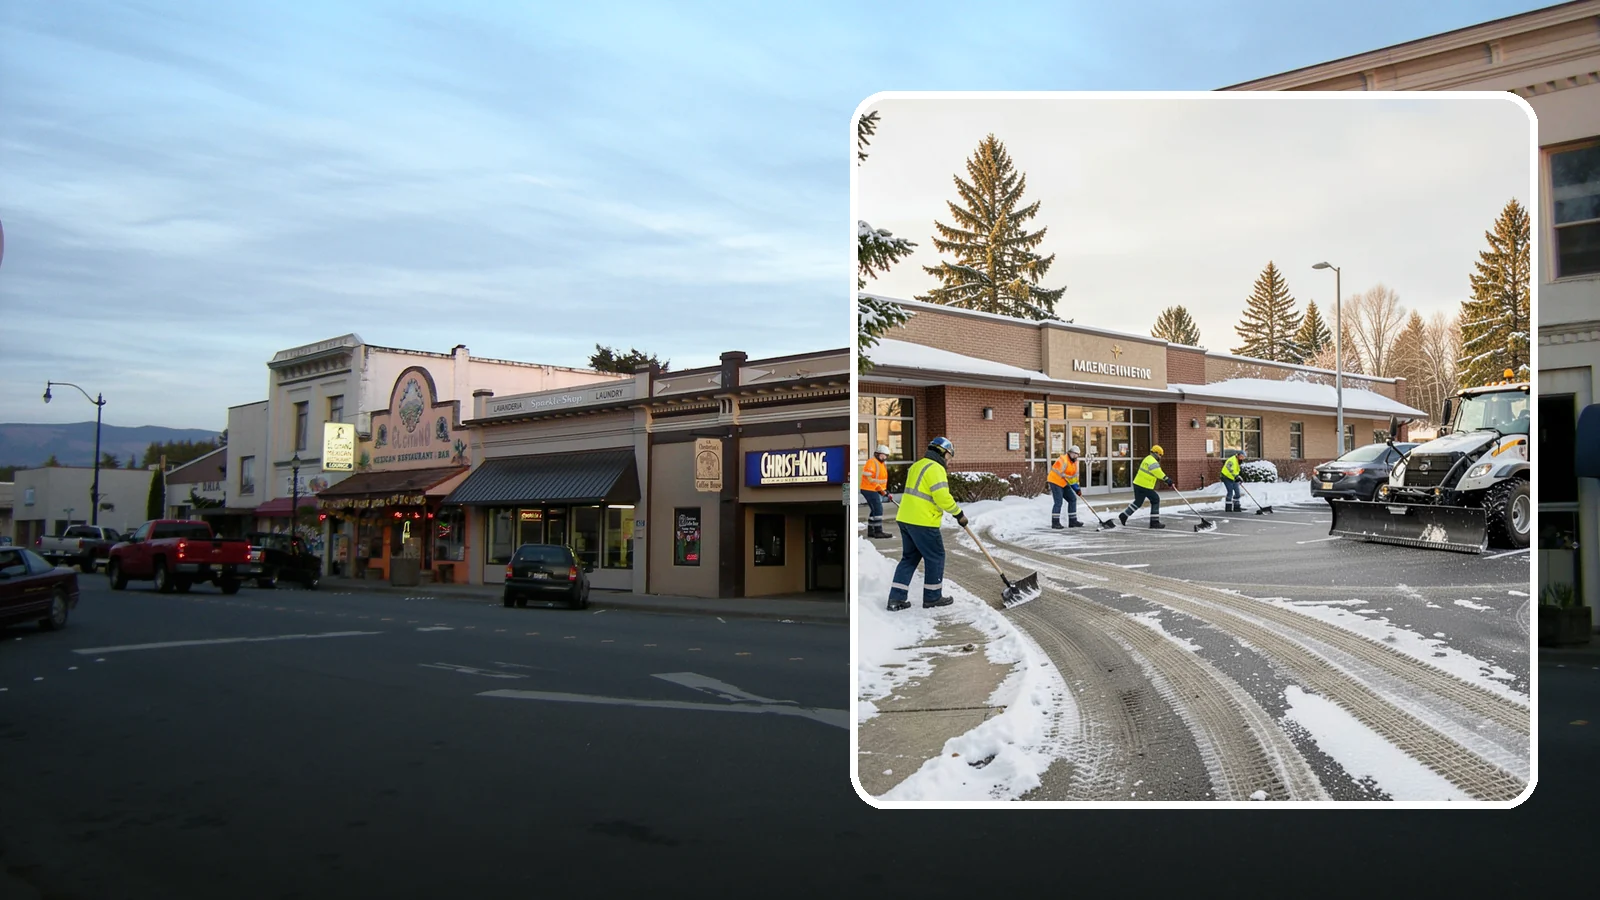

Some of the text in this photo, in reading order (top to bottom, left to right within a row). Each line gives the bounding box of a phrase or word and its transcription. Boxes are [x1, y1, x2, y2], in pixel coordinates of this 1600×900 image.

[596, 389, 623, 400] LAUNDRY
[494, 402, 522, 412] LAVANDERIA
[397, 452, 433, 462] RESTAURANT
[438, 450, 450, 458] BAR
[760, 450, 828, 478] CHRIST KING
